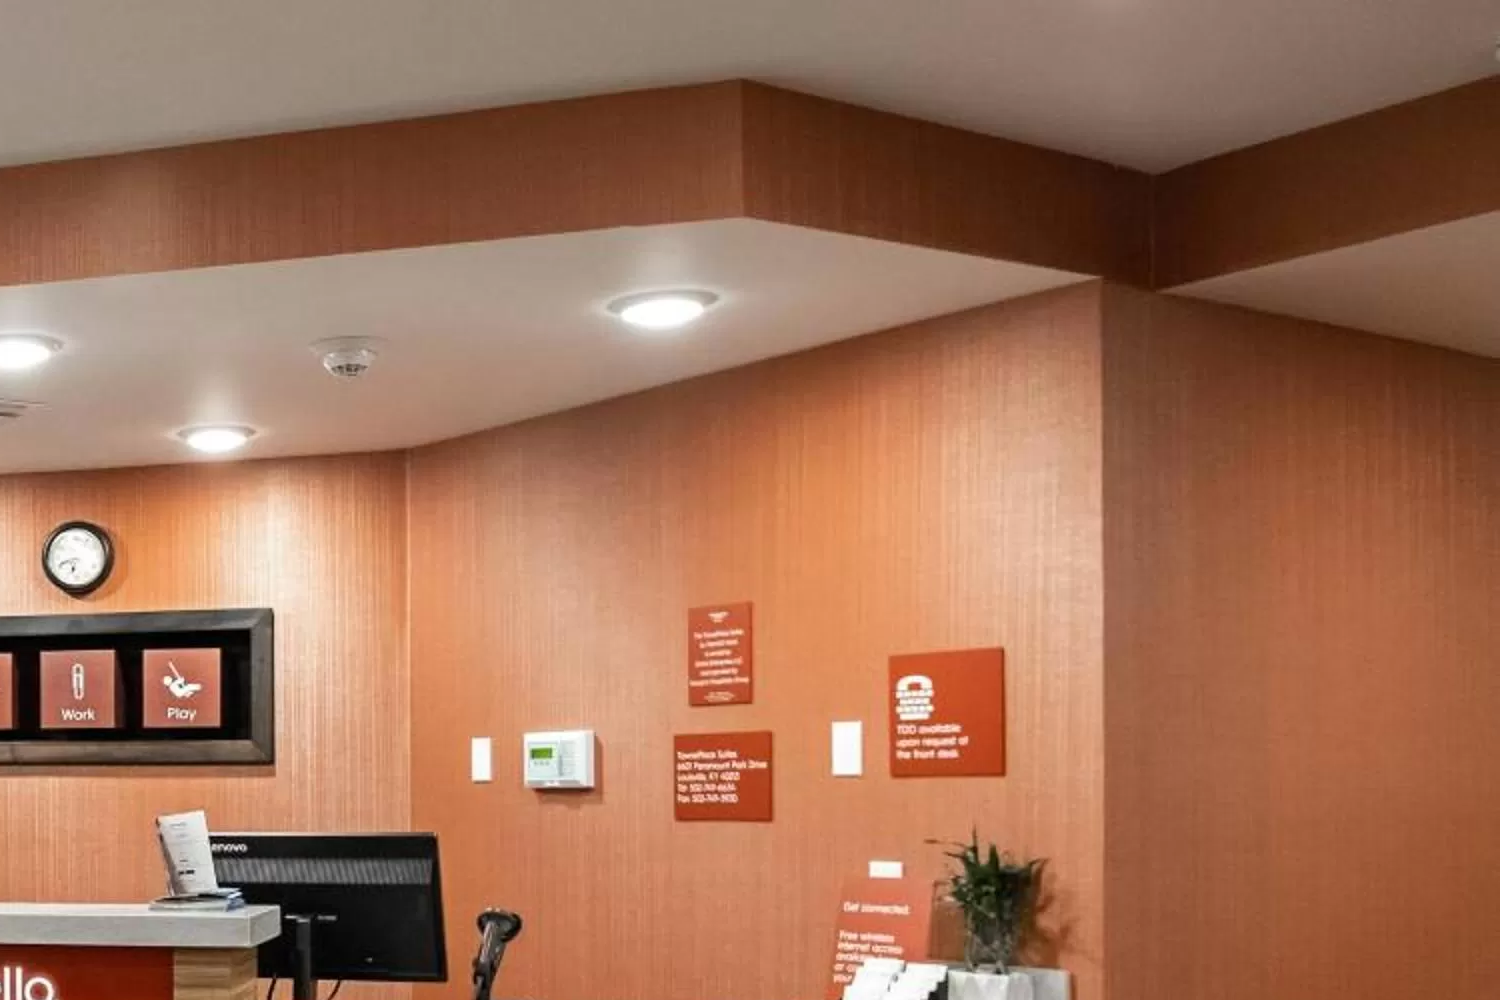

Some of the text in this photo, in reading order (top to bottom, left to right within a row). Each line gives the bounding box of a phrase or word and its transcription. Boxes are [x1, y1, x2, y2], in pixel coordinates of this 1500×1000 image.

[61, 707, 96, 721] Work
[167, 706, 196, 720] Play
[211, 843, 248, 852] enovo
